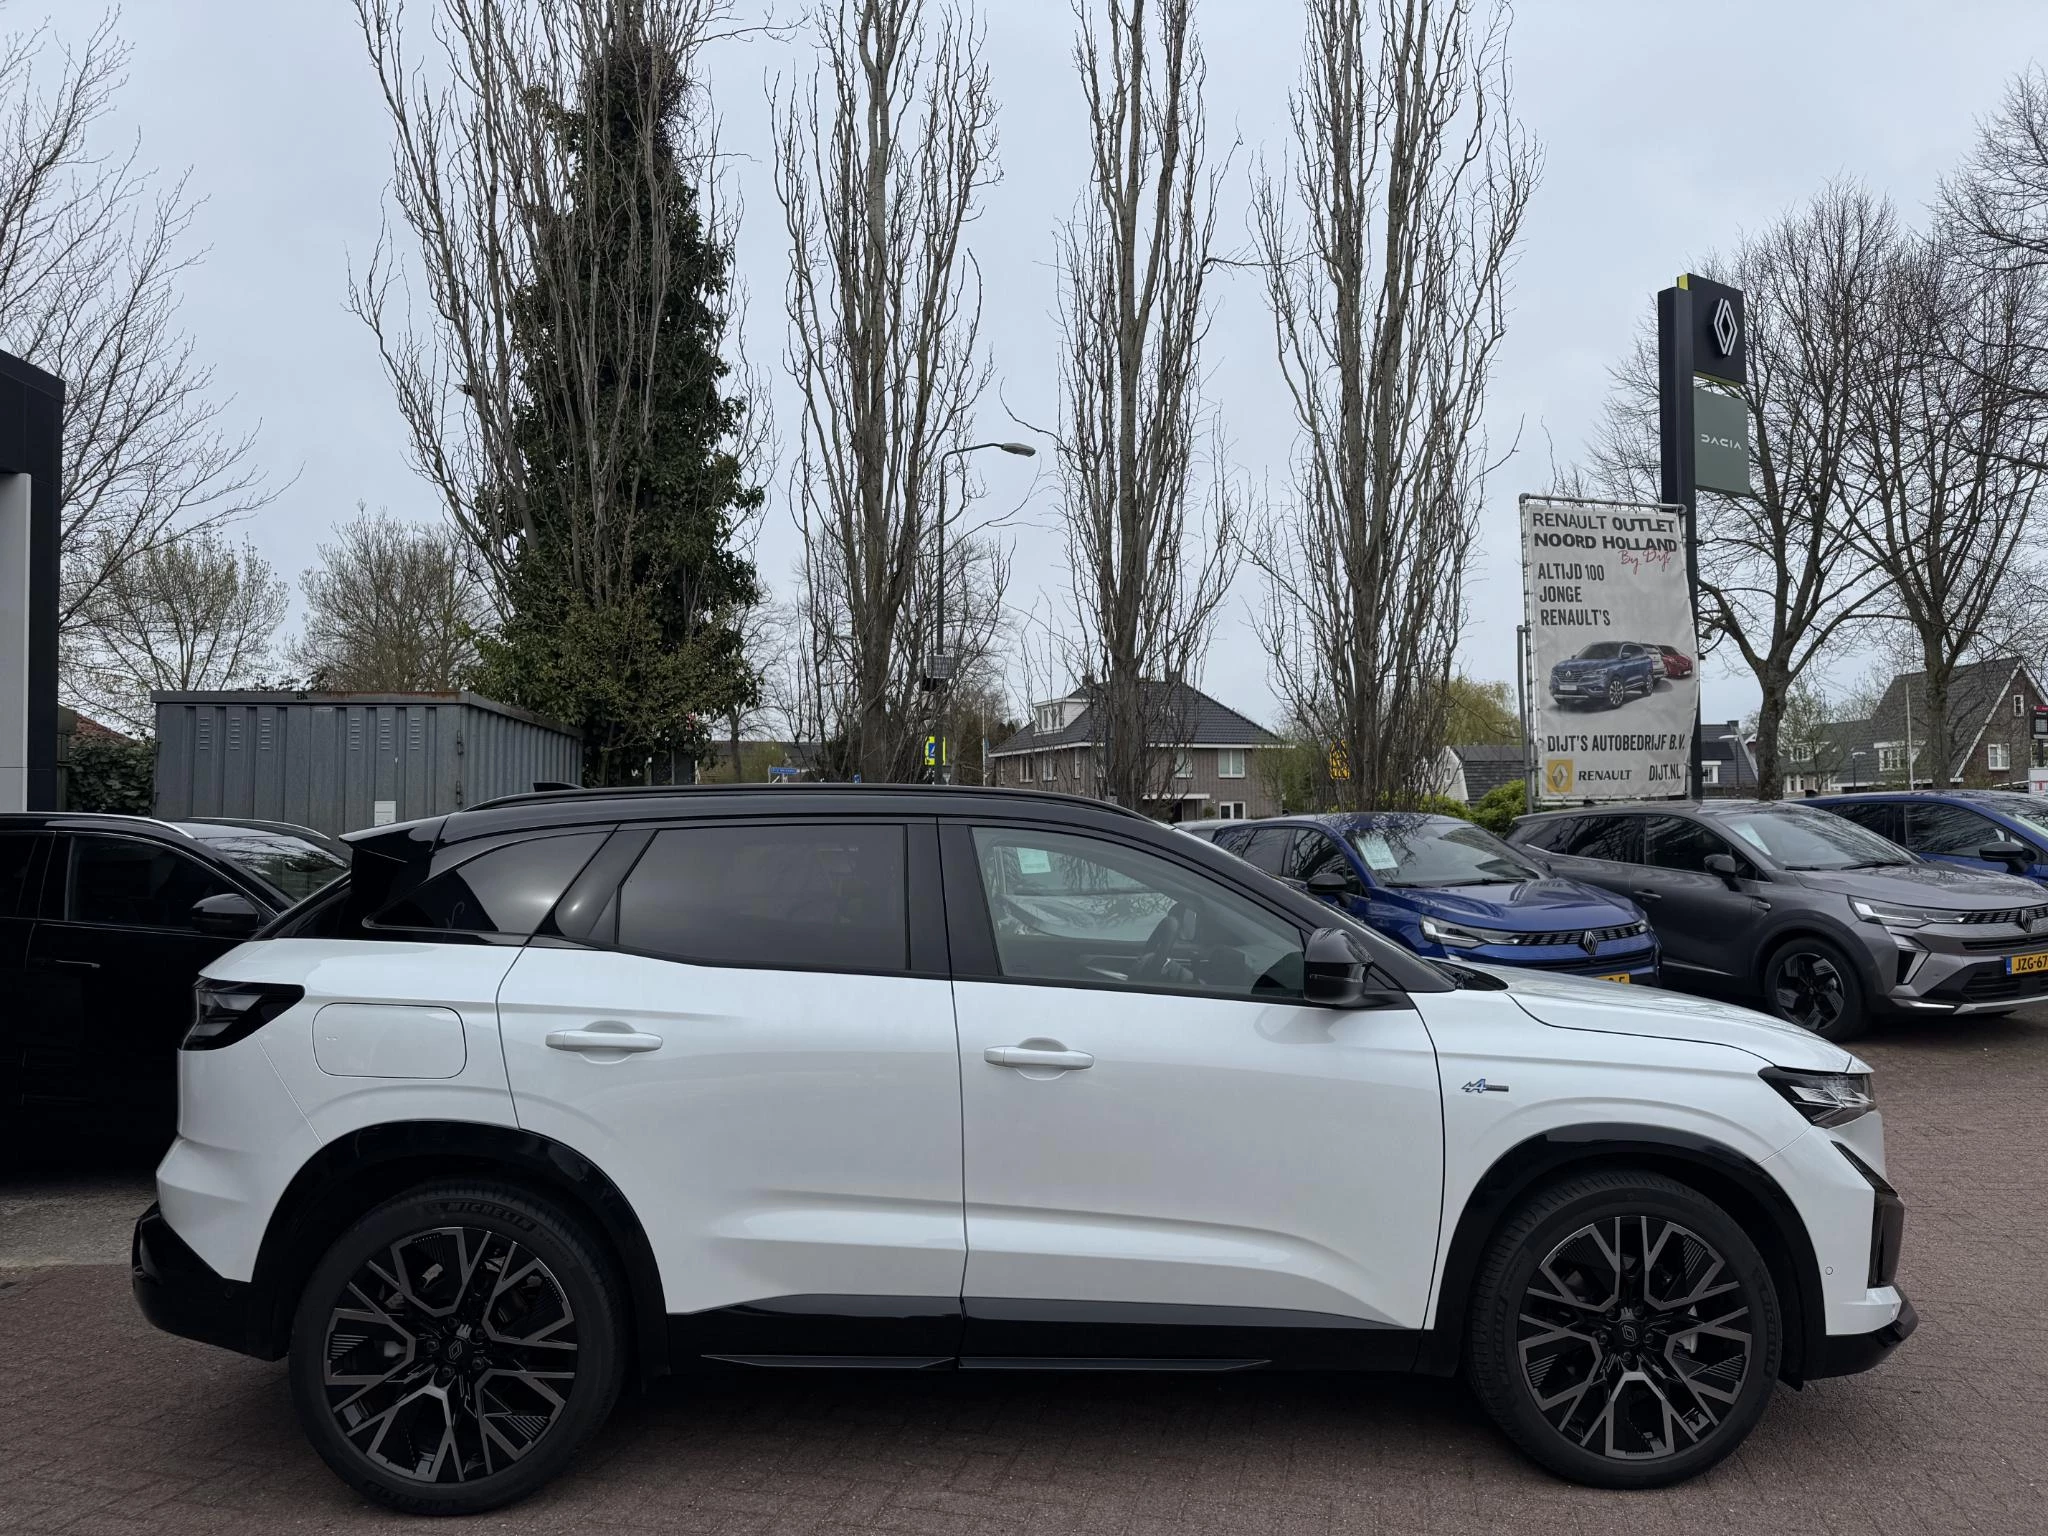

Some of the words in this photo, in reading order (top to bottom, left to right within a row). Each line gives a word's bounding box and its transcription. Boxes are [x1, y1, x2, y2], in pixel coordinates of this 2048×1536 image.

[1700, 433, 1742, 450] DACIA
[1532, 512, 1607, 530] RENAULT
[1612, 516, 1675, 533] OUTLET
[1534, 532, 1597, 549] NOORD
[1602, 535, 1677, 552] HOLLAND
[1617, 549, 1641, 575] By
[1537, 563, 1582, 580] ALTIJD
[1585, 564, 1605, 581] 100
[1539, 586, 1582, 603] JONGE
[1540, 608, 1611, 626] RENAULT'S
[1547, 735, 1588, 752] DIJT'S
[1591, 734, 1667, 751] AUTOBEDRIJF
[1669, 733, 1685, 750] B.V.
[1578, 769, 1633, 782] RENAULT
[1648, 764, 1681, 781] DIJT.NL
